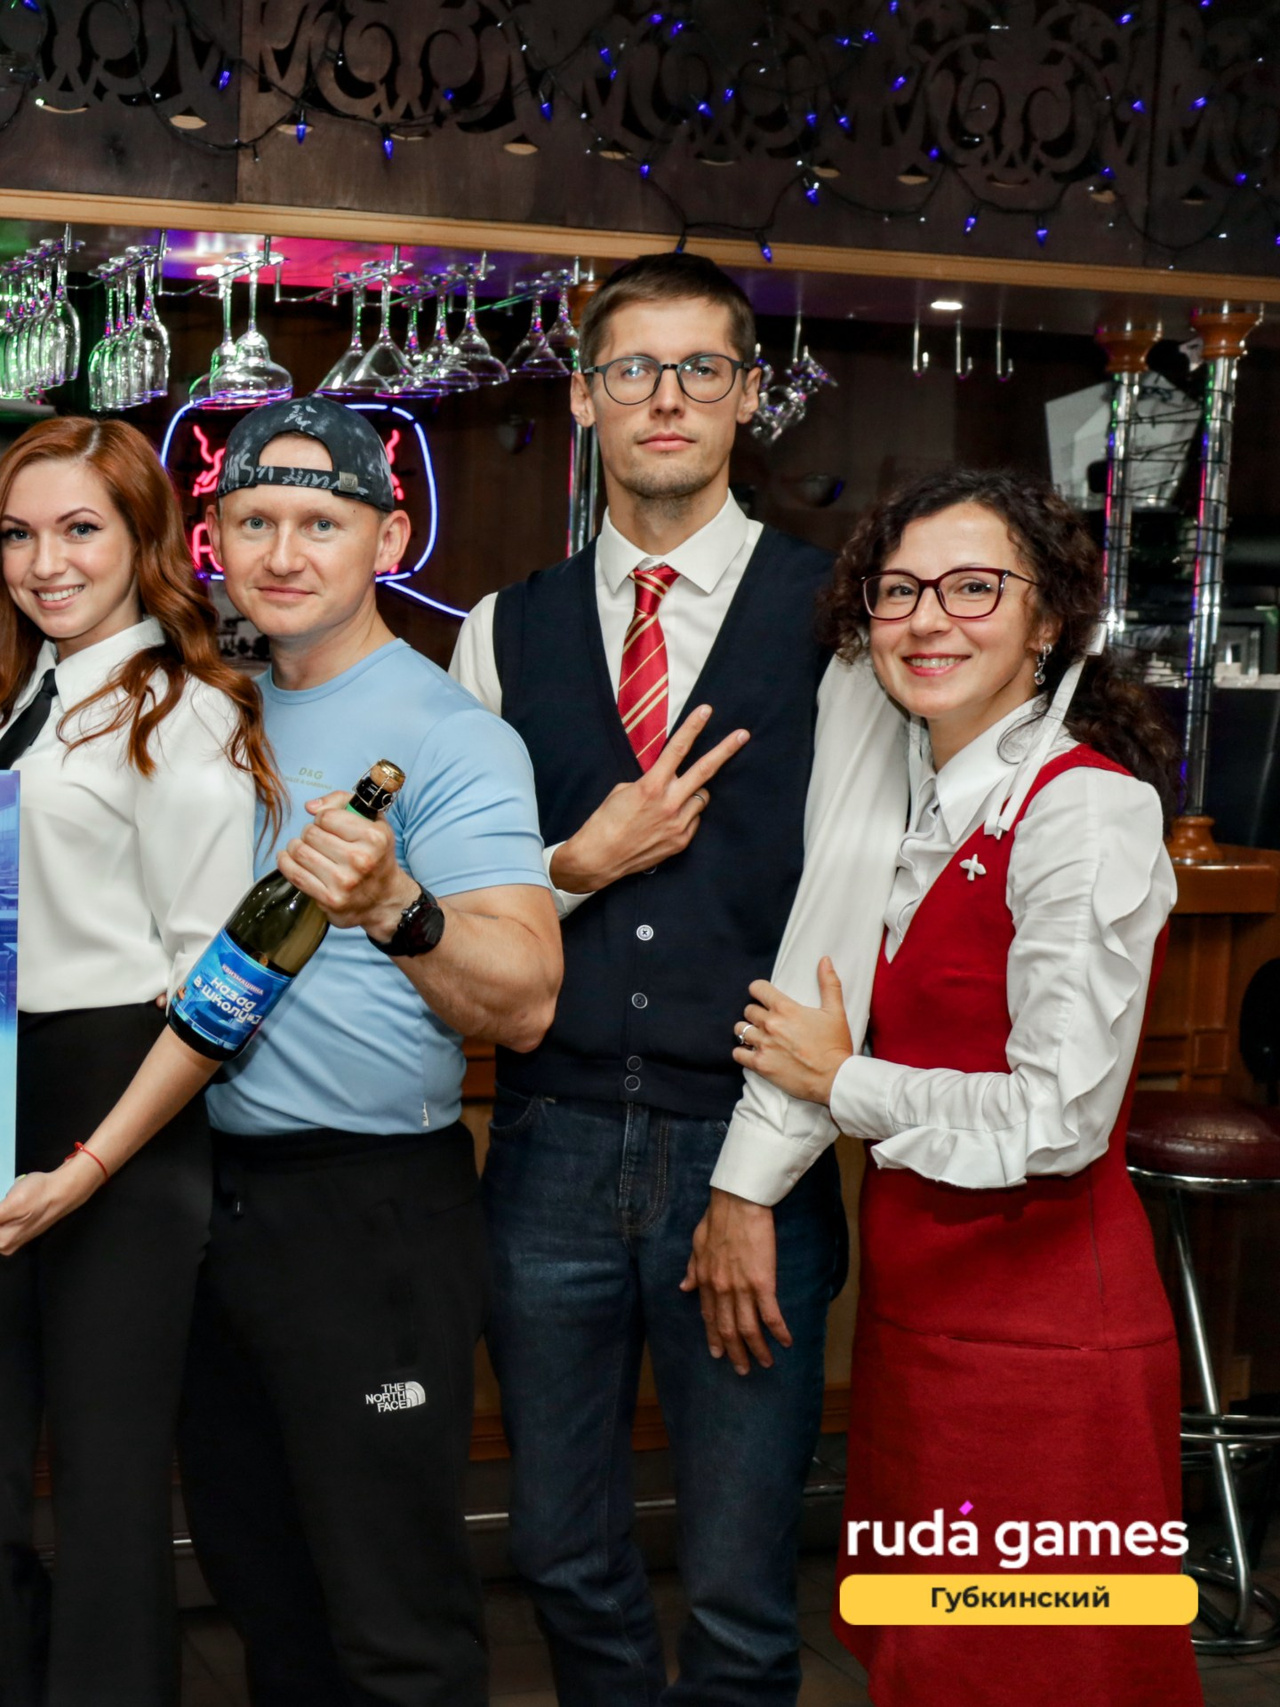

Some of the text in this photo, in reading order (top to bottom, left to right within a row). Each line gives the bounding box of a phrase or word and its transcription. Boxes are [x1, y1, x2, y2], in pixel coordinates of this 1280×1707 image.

[299, 767, 324, 780] D&G
[222, 963, 264, 995] КВИЗМАШИНА
[381, 1382, 405, 1393] THE
[365, 1391, 406, 1405] NORTH
[377, 1400, 407, 1413] FACE
